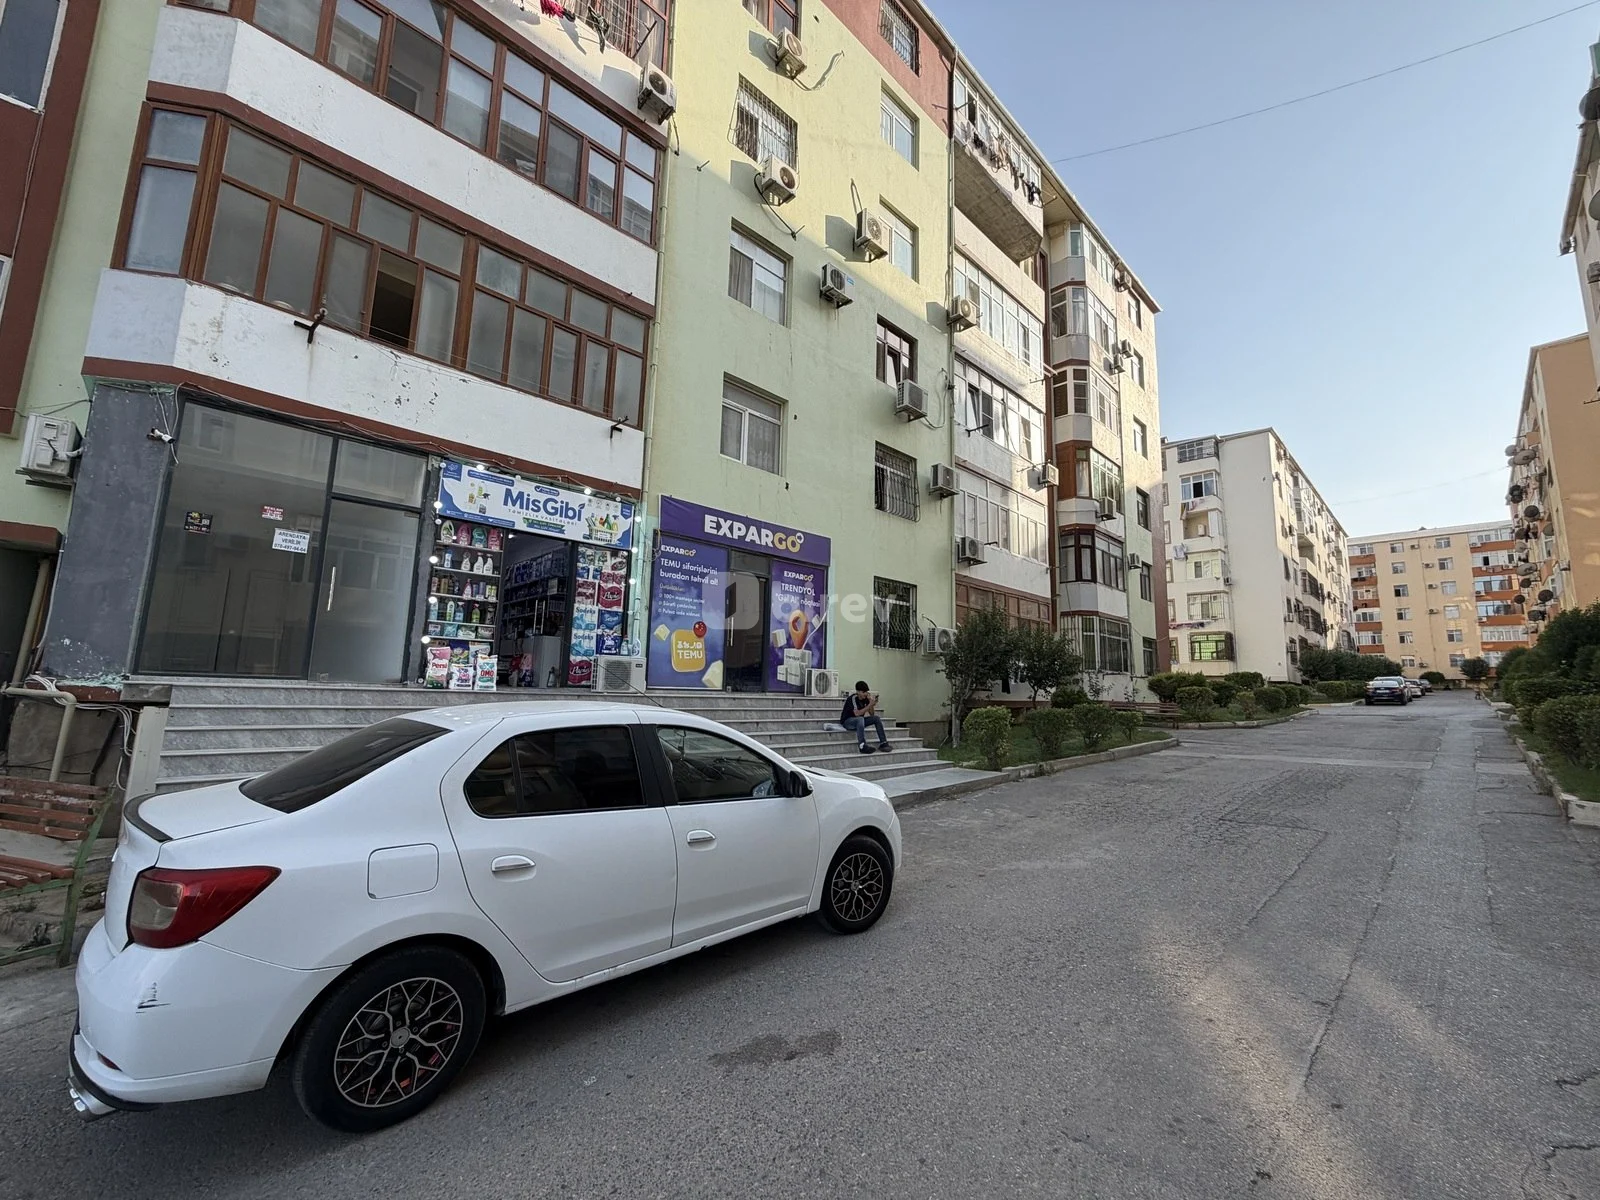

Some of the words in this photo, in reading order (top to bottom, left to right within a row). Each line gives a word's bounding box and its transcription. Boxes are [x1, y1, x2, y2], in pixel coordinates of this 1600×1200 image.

[503, 488, 585, 522] MisGibi
[704, 514, 803, 553] EXPARGO
[661, 545, 696, 557] EXPARGO
[660, 558, 681, 569] TEMU
[784, 570, 814, 582] EXPARGO
[781, 583, 816, 597] TRENDYOL
[677, 650, 703, 660] TEMU
